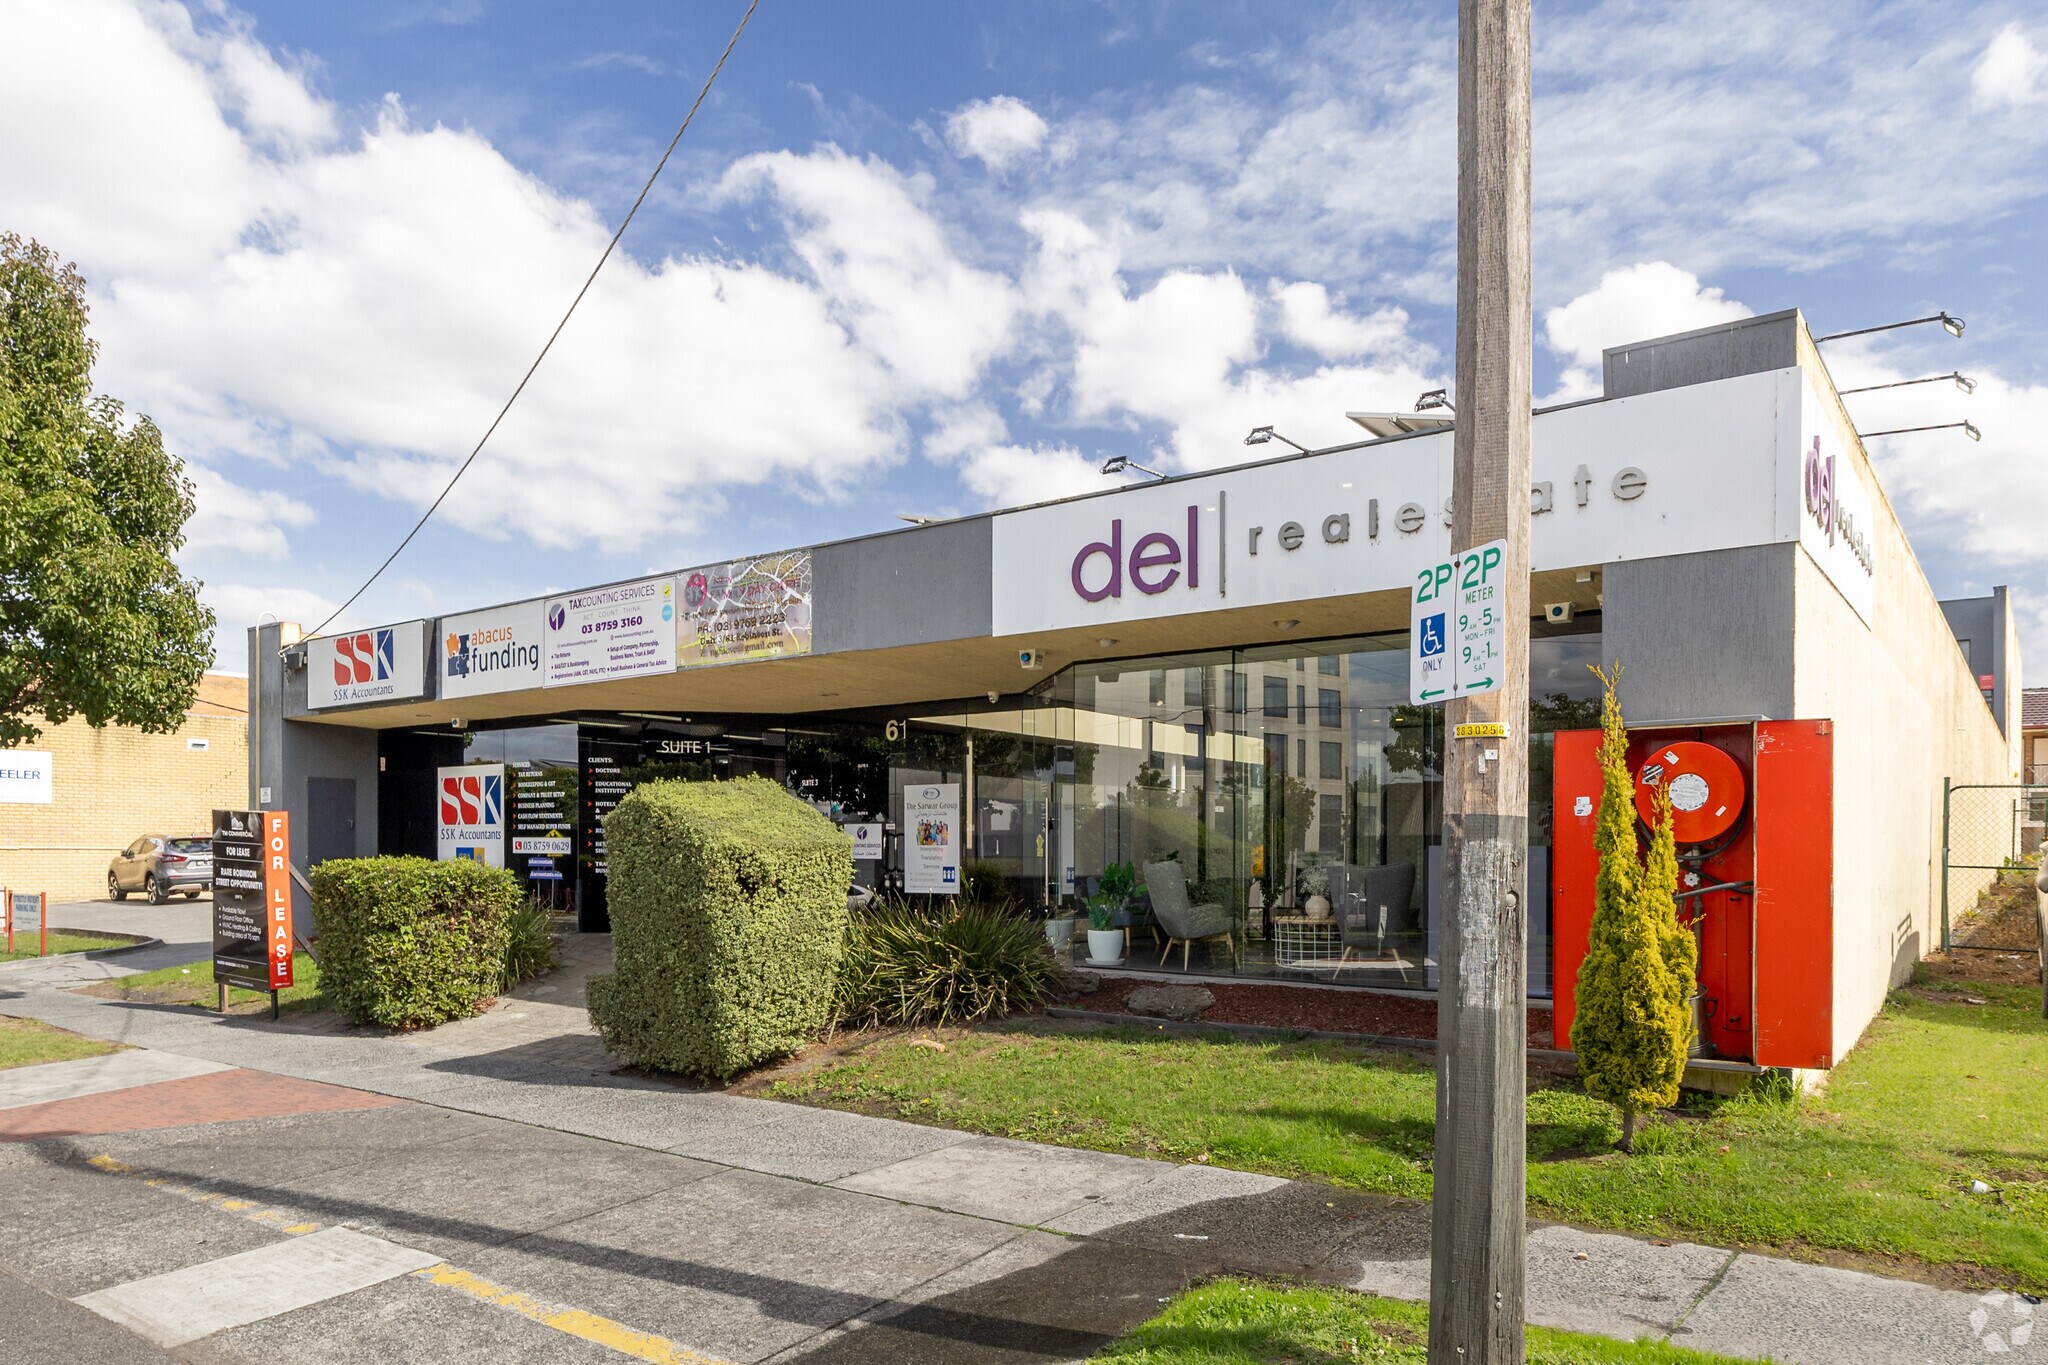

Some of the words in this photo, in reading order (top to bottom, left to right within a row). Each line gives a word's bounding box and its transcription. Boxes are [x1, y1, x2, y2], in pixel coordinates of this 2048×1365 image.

[1071, 505, 1199, 602] del
[1249, 464, 1647, 555] realeate
[1462, 547, 1500, 590] 2P
[1416, 563, 1453, 604] 2P
[569, 588, 619, 610] TAXCOUNTING
[620, 584, 655, 601] SERVICES
[1465, 587, 1493, 605] METER
[598, 609, 618, 619] COUNT
[623, 606, 641, 614] THINK
[581, 624, 593, 634] 03
[595, 620, 618, 632] 8759
[621, 616, 643, 628] 3160
[471, 626, 513, 646] abacus
[334, 629, 394, 686] SSK
[471, 642, 539, 674] funding
[1423, 658, 1443, 672] ONLY
[1473, 663, 1486, 672] SAT
[334, 688, 349, 701] SSK
[351, 685, 394, 699] Accountants
[886, 720, 906, 742] 61
[661, 740, 701, 753] SUITE
[705, 742, 711, 754] 1
[441, 775, 501, 826] SSK
[917, 802, 938, 810] Sarwar
[940, 802, 958, 811] Group
[271, 818, 284, 870] FOR
[441, 829, 456, 840] SSK
[459, 829, 502, 840] Accountants
[226, 847, 236, 856] FOR
[236, 847, 251, 858] LEASE
[523, 841, 532, 851] 03
[533, 841, 551, 851] 8759
[552, 841, 570, 851] 0629
[274, 888, 287, 977] LEASE
